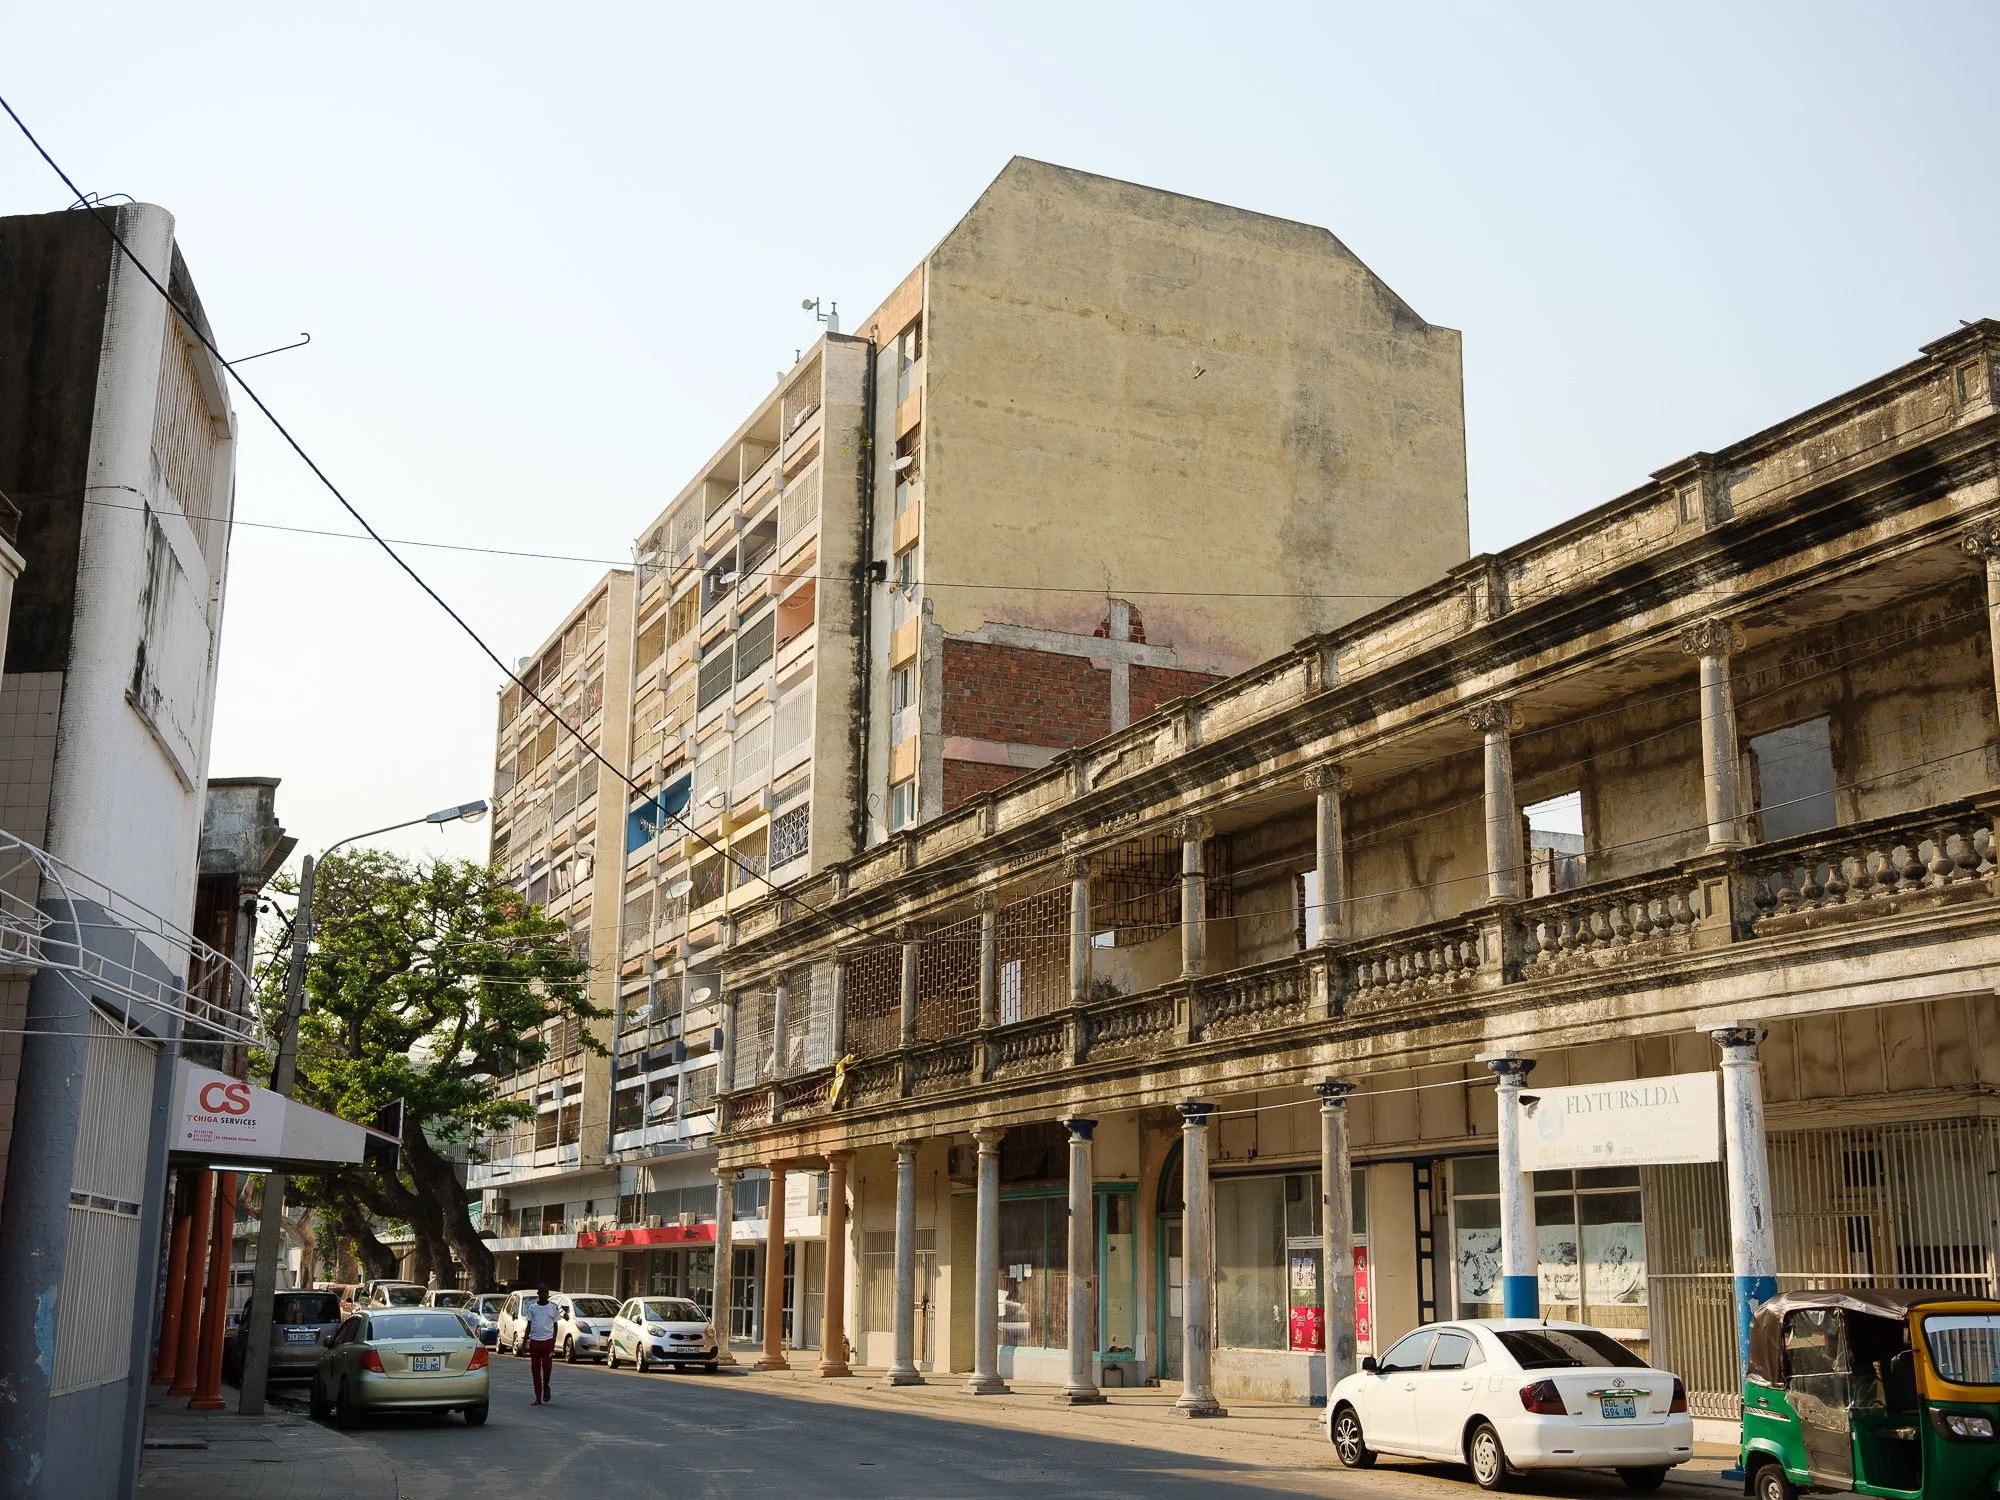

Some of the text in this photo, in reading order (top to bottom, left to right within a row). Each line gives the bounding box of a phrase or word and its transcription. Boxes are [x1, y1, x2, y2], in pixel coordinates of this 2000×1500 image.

[199, 1081, 251, 1115] CS
[186, 1114, 256, 1126] TCHIGA SERVICES
[1604, 1399, 1618, 1407] AGL
[1605, 1407, 1634, 1416] 594 MC
